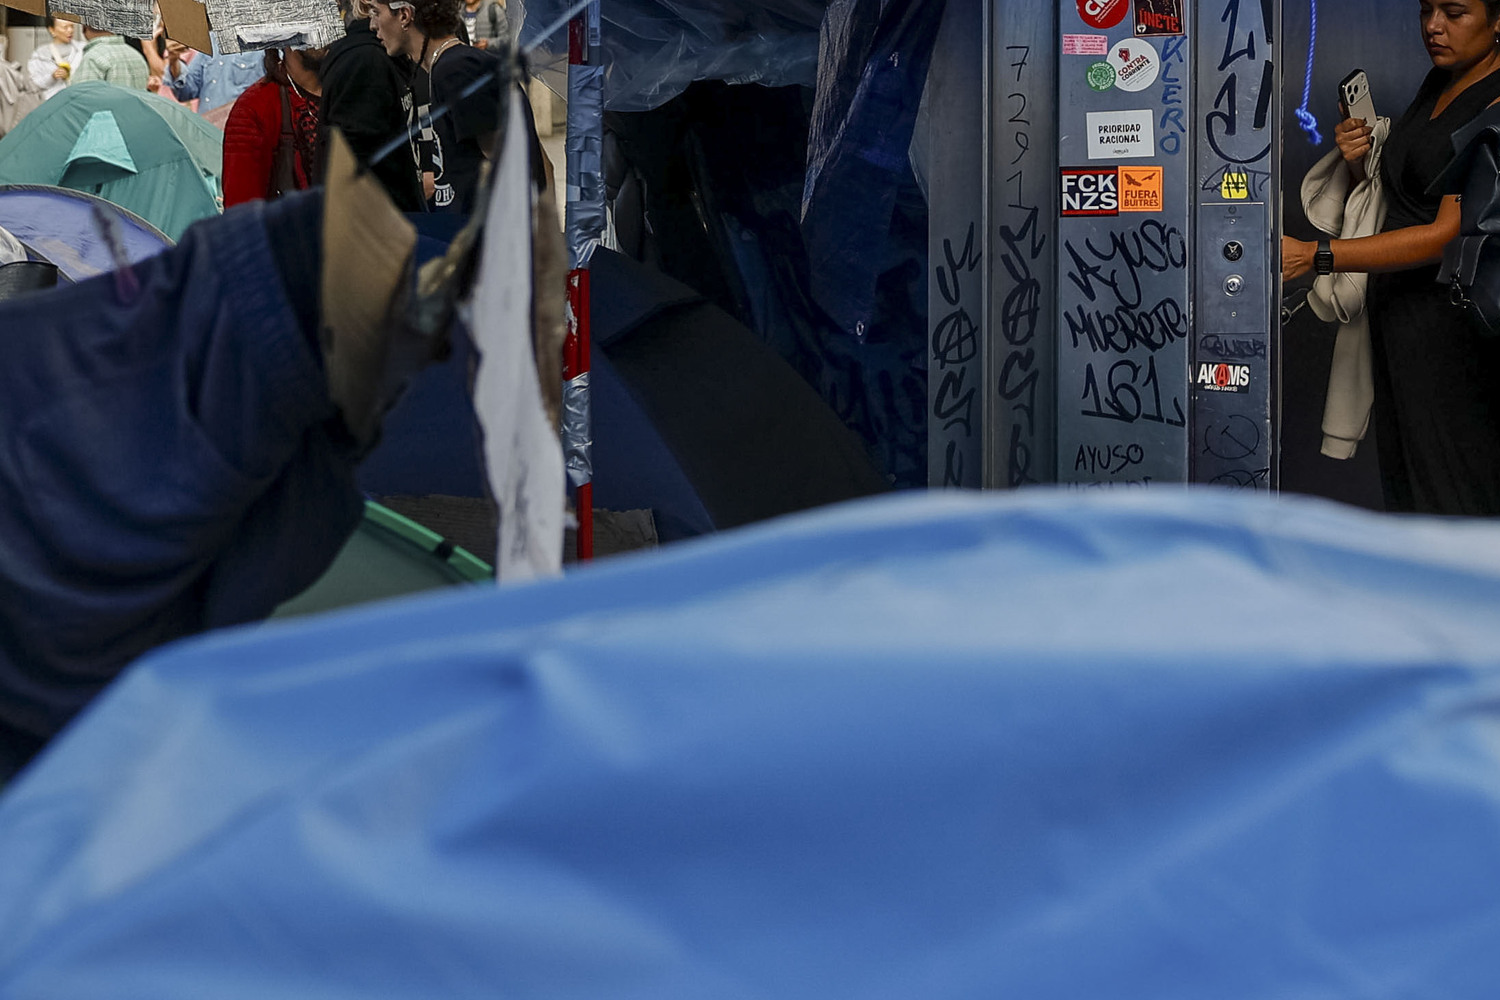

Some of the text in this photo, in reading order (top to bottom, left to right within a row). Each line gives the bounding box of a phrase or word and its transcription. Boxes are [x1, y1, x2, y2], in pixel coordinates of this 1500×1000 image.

[1139, 8, 1179, 32] ÚNETE
[1118, 54, 1147, 77] CONTRA
[1121, 58, 1151, 81] CORRIENTE
[1098, 123, 1141, 134] PRIORIDAD
[1099, 134, 1141, 145] RACIONAL
[1062, 174, 1116, 193] FCK
[1062, 192, 1118, 211] NZS
[1124, 190, 1158, 199] FUERA
[1124, 199, 1159, 207] BUITRES
[1064, 219, 1187, 309] AYUSO
[1075, 443, 1144, 475] AYUSO
